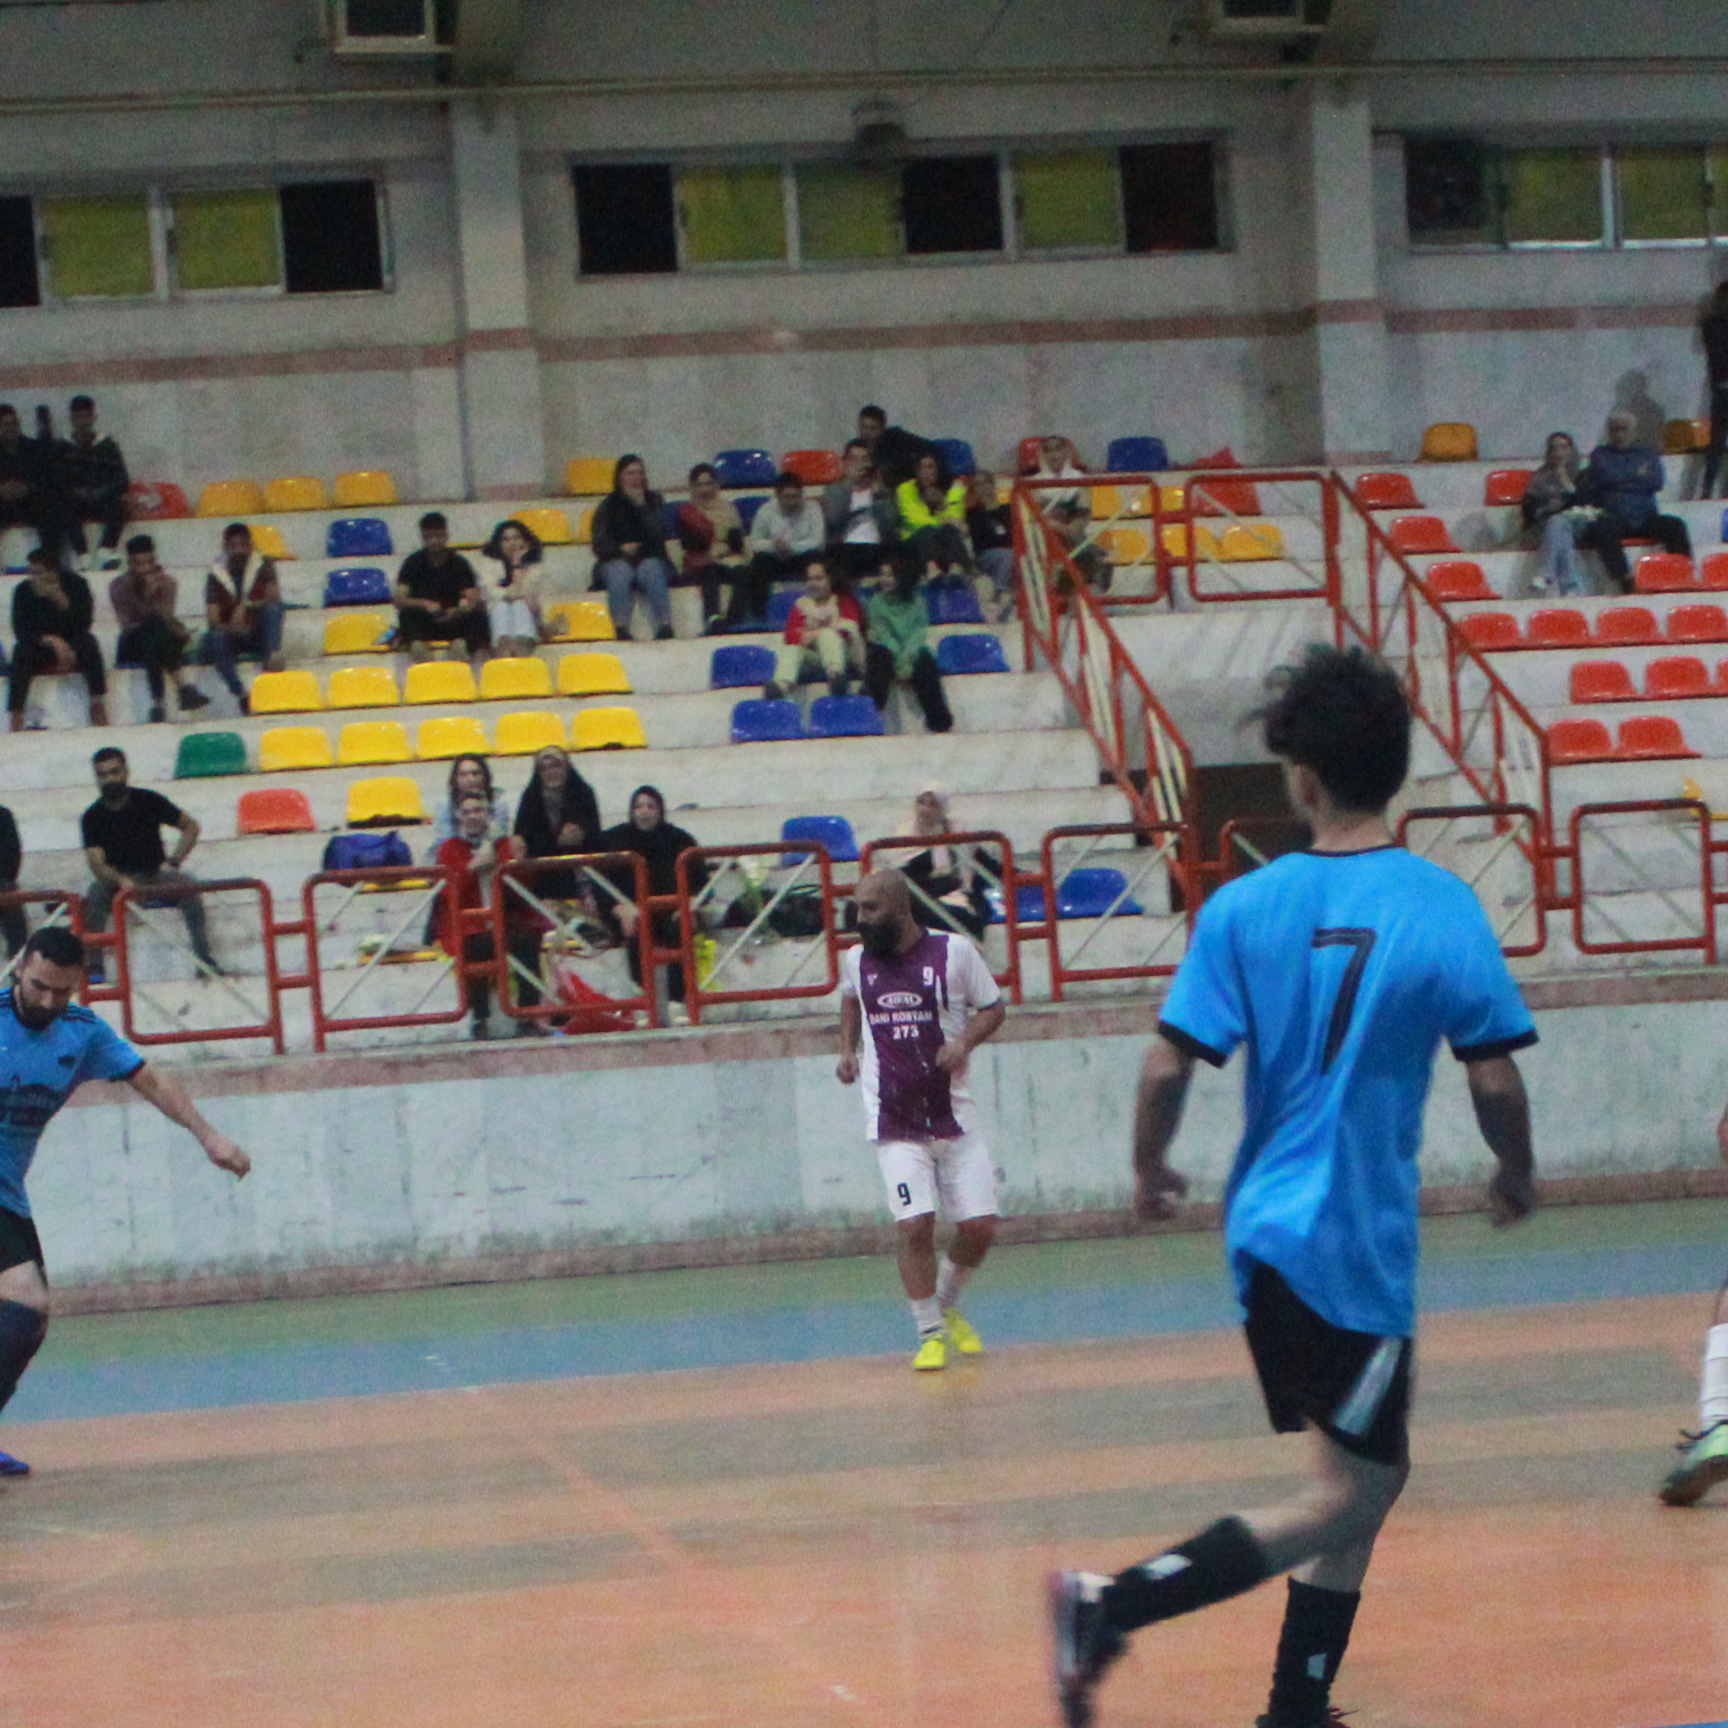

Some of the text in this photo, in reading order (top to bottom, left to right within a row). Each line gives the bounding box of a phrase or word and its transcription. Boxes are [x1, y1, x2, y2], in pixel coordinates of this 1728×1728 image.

[922, 966, 934, 985] 9
[1312, 927, 1377, 1076] 7
[892, 1025, 920, 1040] 273
[897, 1182, 911, 1206] 9
